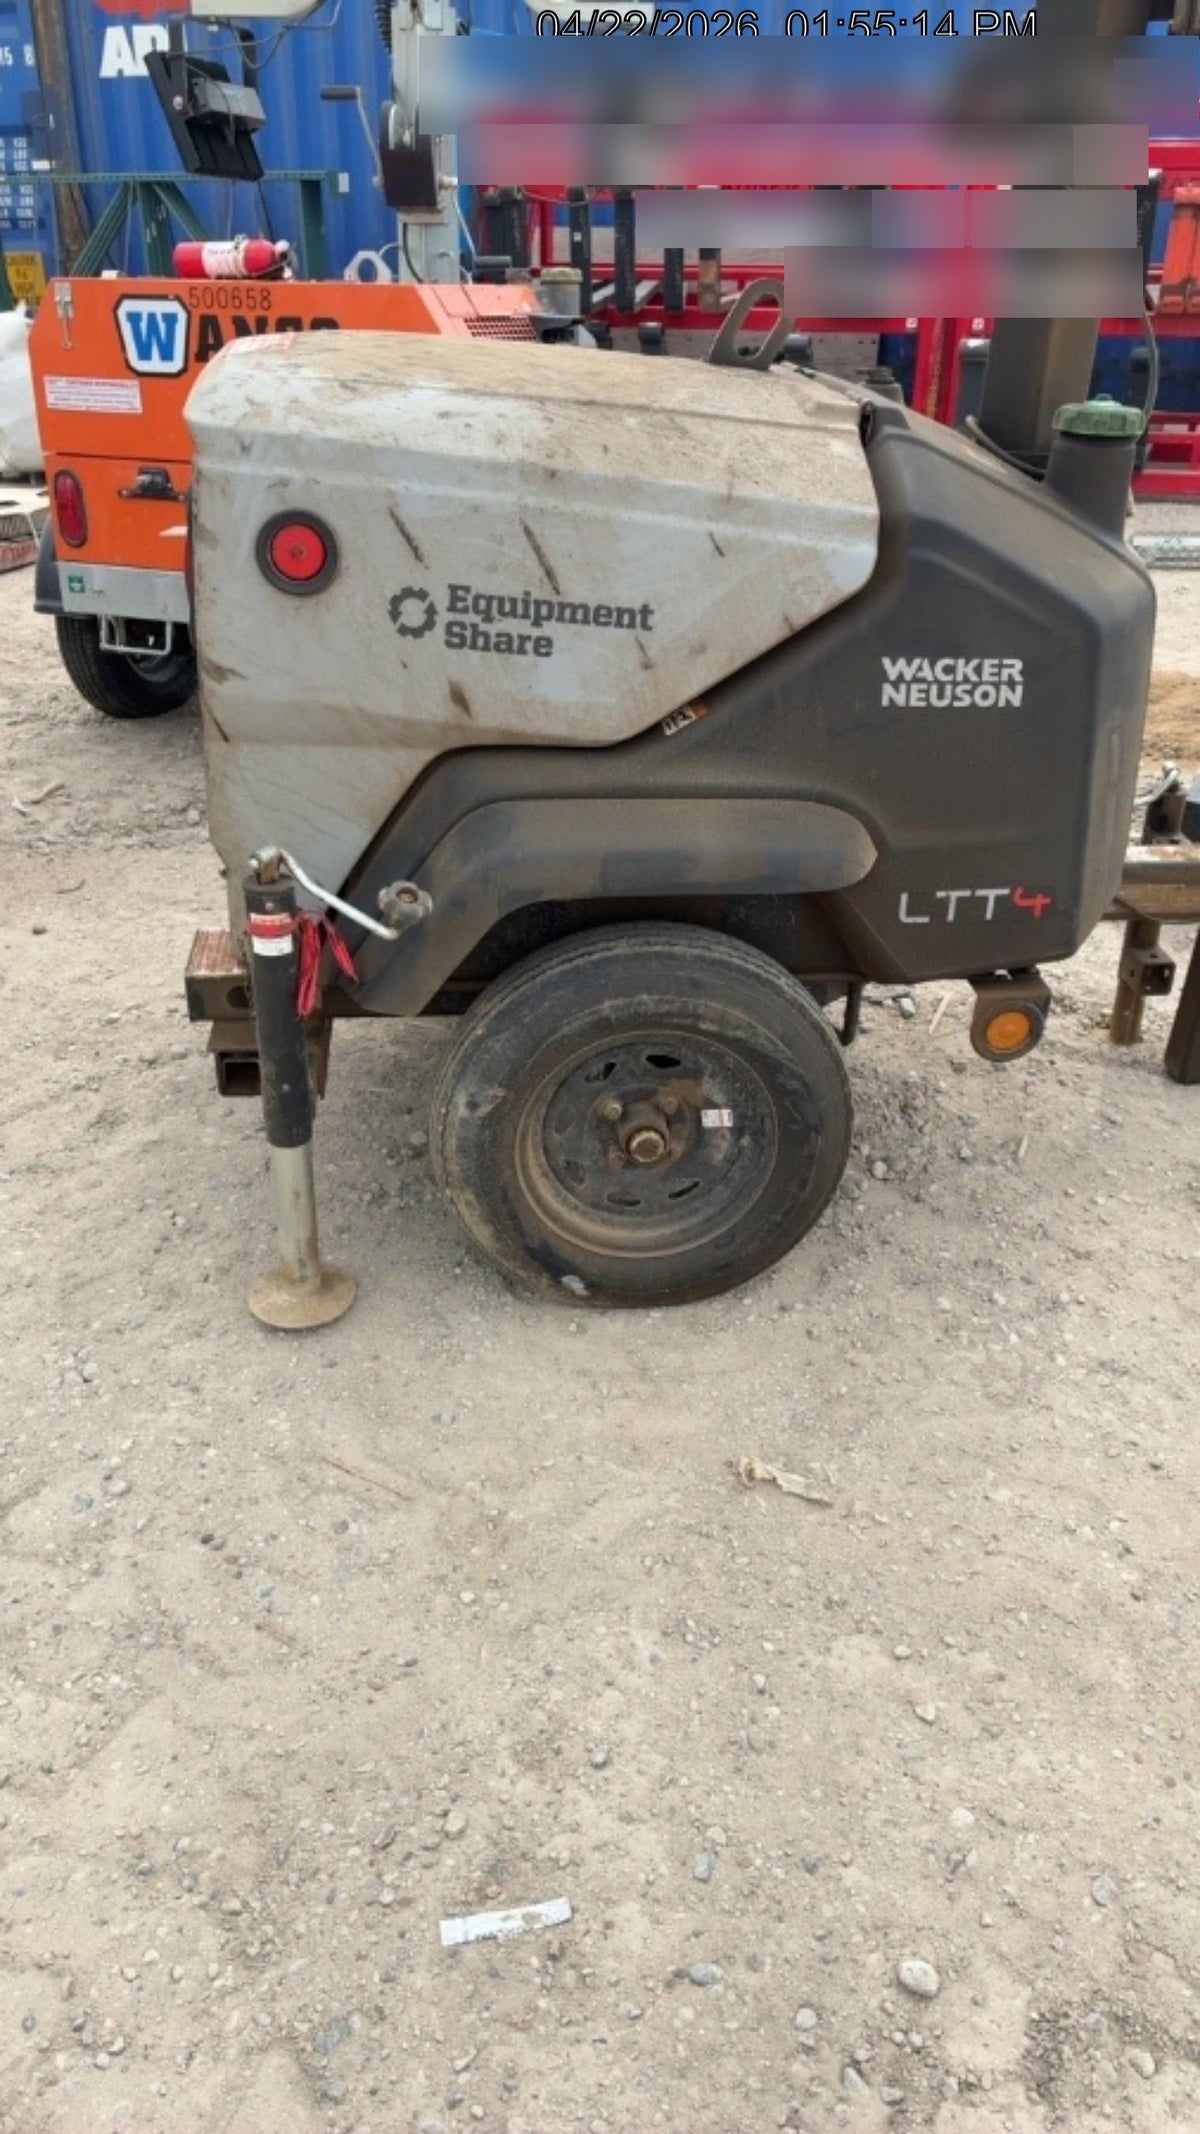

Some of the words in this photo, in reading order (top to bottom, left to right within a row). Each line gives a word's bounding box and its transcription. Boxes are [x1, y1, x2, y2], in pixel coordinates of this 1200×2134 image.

[99, 23, 188, 78] AP
[188, 286, 273, 311] 500658
[446, 582, 655, 631] Equipment
[444, 620, 554, 658] Share
[881, 656, 1024, 682] WACKER
[881, 683, 1024, 708] NEUSON
[898, 886, 1052, 924] LTT4
